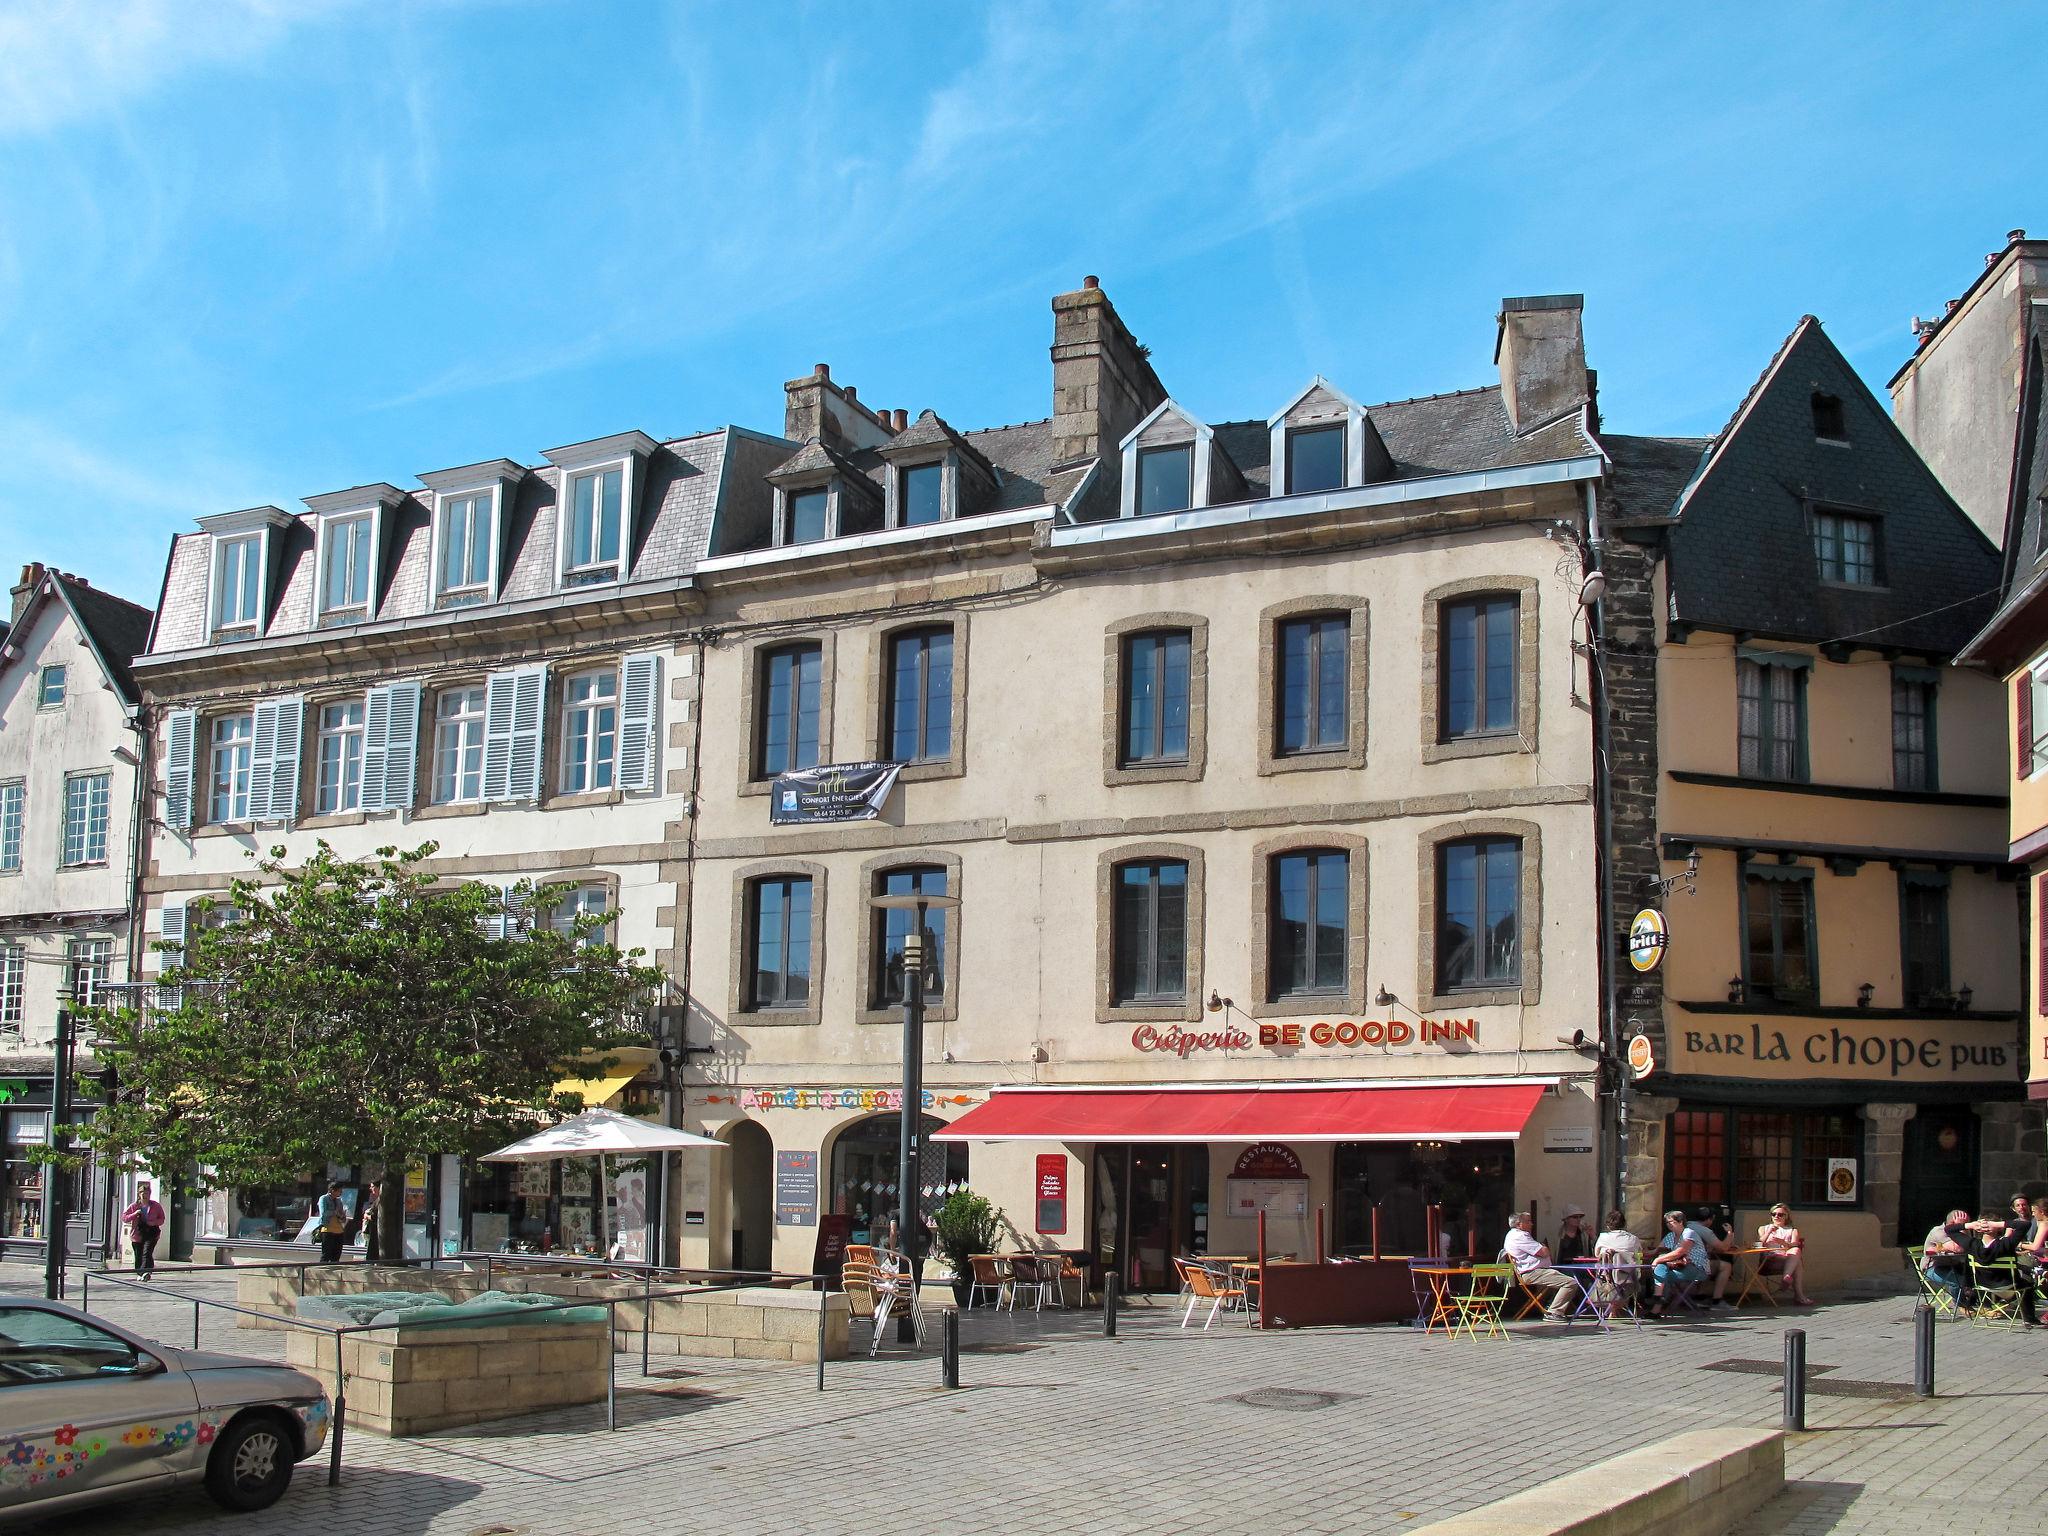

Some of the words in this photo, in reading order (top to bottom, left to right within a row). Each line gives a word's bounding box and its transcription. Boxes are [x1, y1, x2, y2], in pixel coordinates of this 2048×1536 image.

[818, 764, 854, 774] CHAUFFAGE
[801, 796, 830, 805] CONFORT
[1630, 934, 1658, 950] Britt
[1131, 1024, 1248, 1057] Crêperie
[1259, 1024, 1301, 1046] BE
[1309, 1021, 1410, 1045] GOOD
[1419, 1018, 1475, 1042] INN
[1685, 1031, 1745, 1055] BAR
[1240, 1145, 1298, 1169] RESTAURANT
